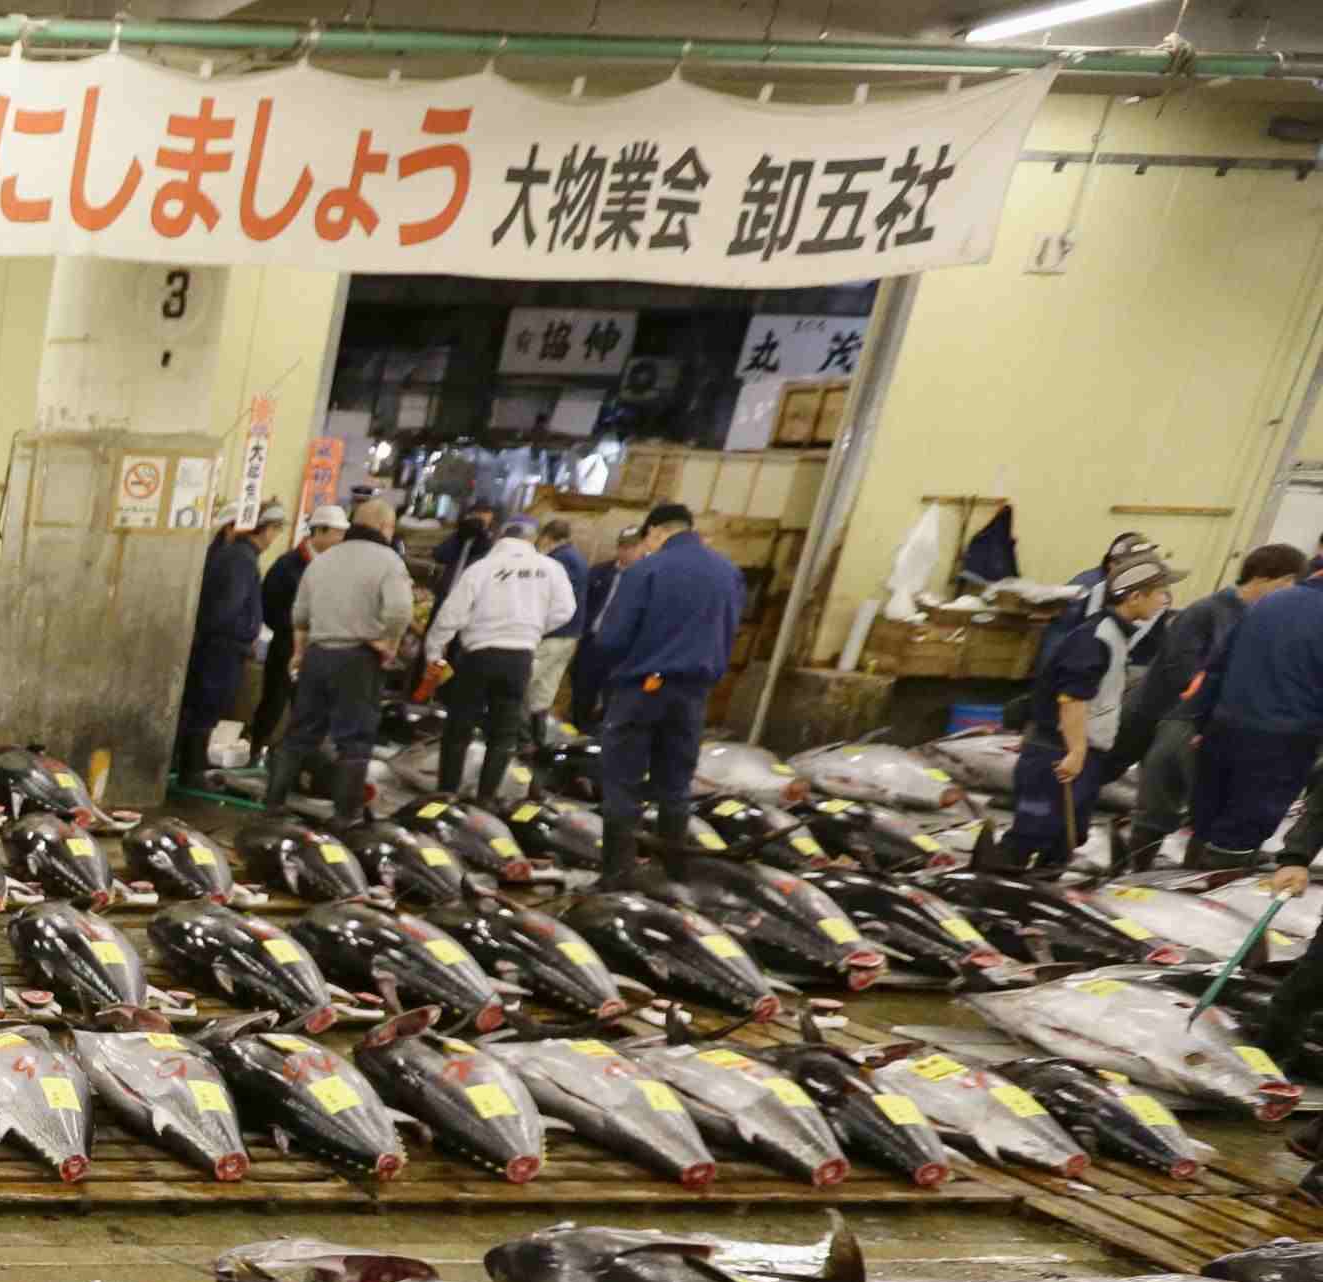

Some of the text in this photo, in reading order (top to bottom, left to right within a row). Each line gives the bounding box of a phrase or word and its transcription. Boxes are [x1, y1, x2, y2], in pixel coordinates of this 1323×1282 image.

[492, 139, 712, 254] 大物業会
[727, 143, 955, 264] 卸五社
[161, 270, 189, 319] 3
